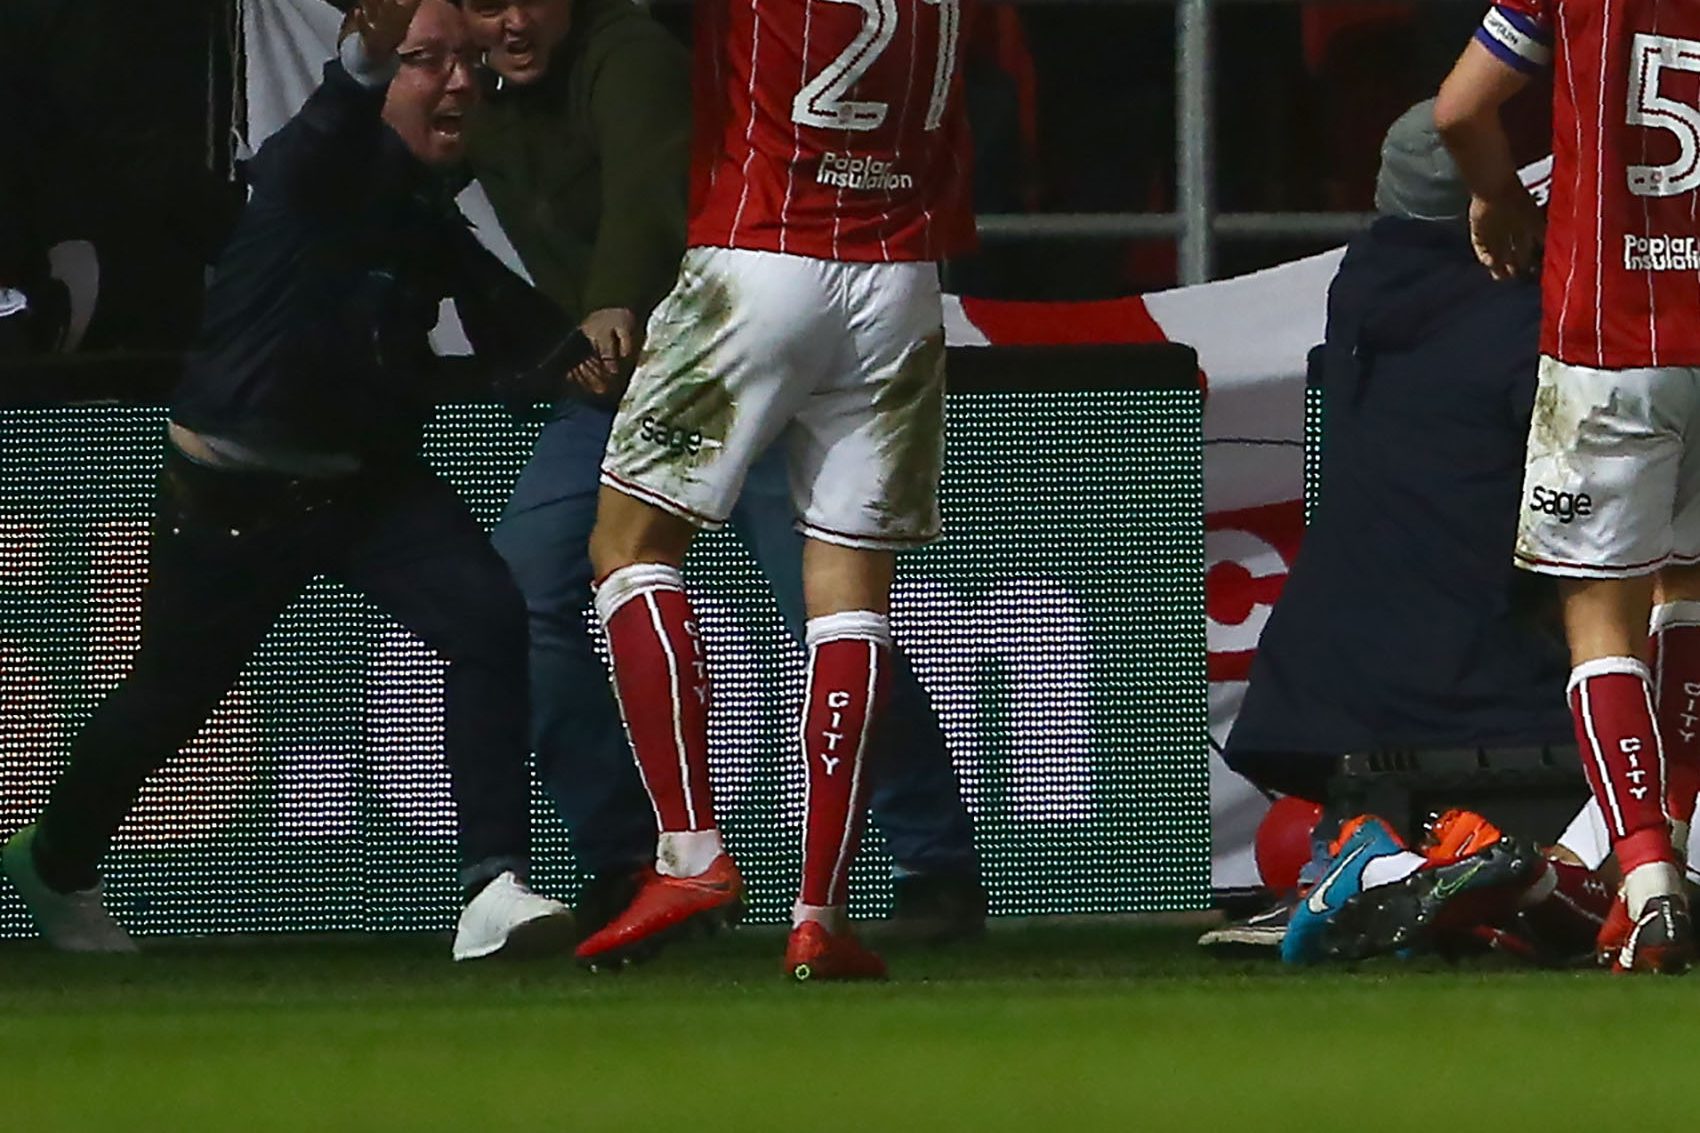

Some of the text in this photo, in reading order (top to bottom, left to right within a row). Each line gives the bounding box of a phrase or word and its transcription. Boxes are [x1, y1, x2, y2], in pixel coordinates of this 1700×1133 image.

[816, 167, 912, 190] Insulation
[823, 151, 893, 176] Poplar
[1623, 234, 1697, 260] Poplar
[641, 417, 702, 456] sage
[1529, 485, 1592, 524] sage
[821, 691, 851, 776] CITY
[1619, 737, 1648, 800] CITY
